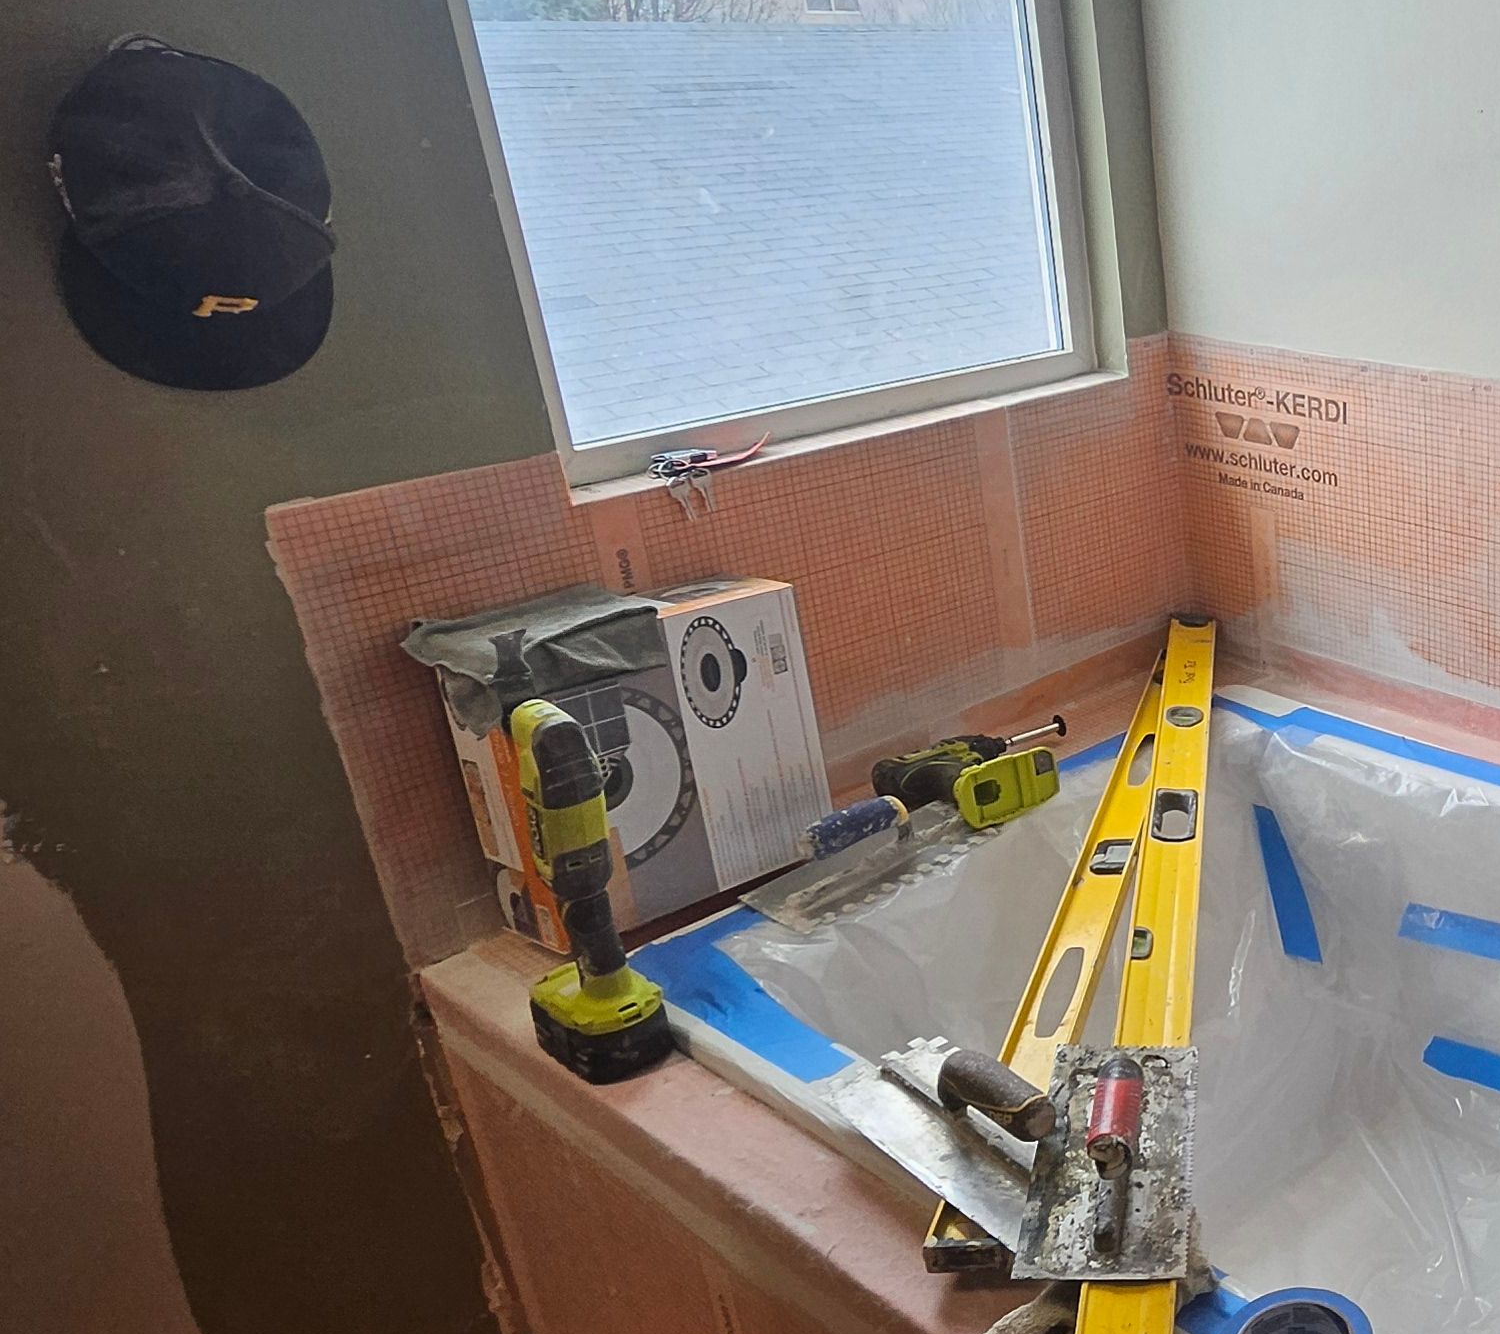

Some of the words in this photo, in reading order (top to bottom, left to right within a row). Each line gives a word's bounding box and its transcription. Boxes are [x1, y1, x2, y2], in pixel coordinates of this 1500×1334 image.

[1186, 441, 1338, 486] www.schluter.com
[1219, 472, 1248, 489] Made
[1250, 478, 1261, 491] in
[1263, 481, 1304, 501] Canada
